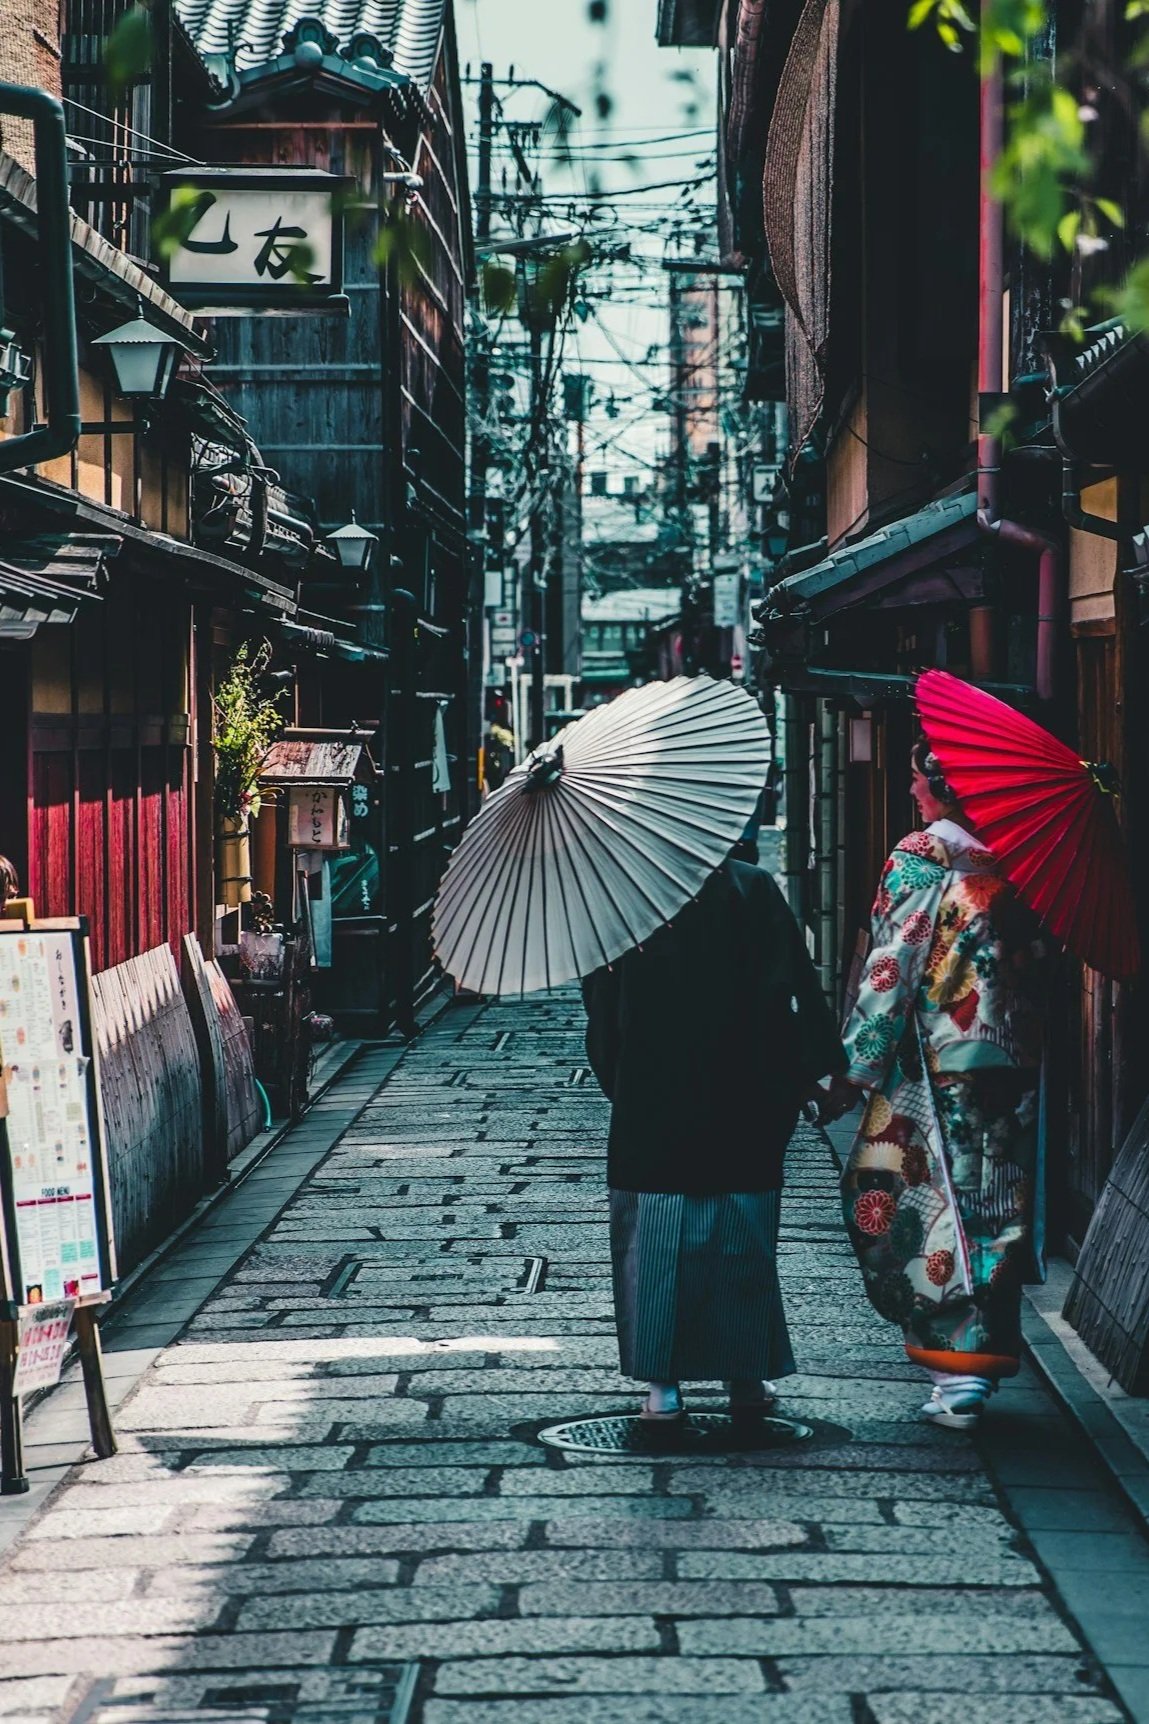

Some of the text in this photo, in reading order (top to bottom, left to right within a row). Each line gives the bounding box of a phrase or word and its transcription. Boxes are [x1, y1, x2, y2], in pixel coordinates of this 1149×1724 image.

[352, 784, 369, 817] 染め
[41, 1185, 70, 1197] FOOD MENU
